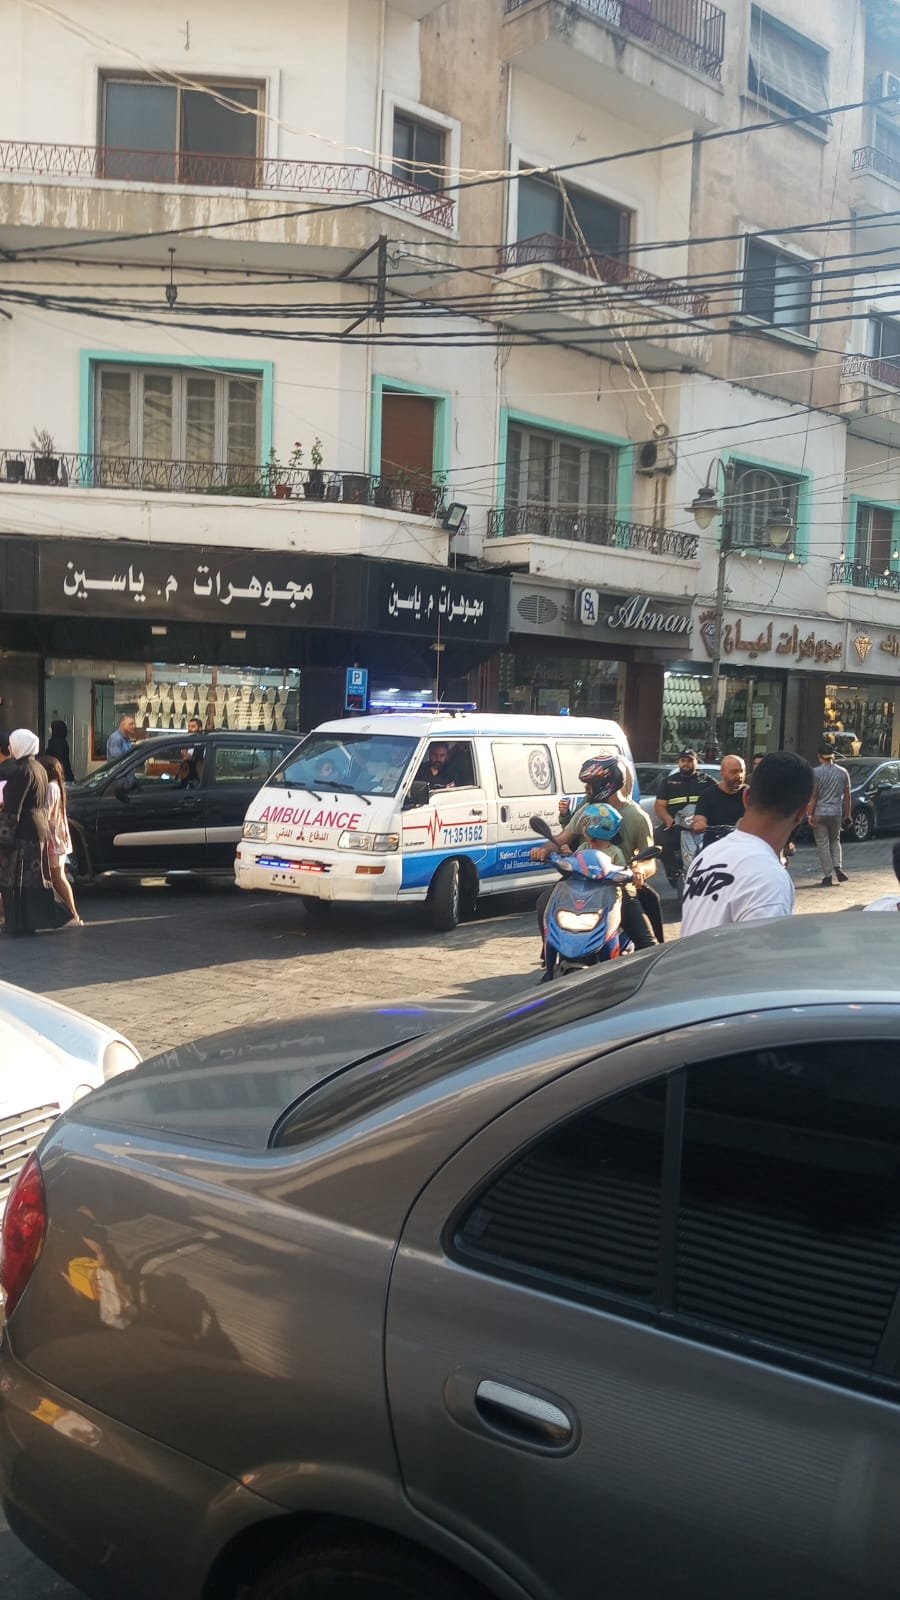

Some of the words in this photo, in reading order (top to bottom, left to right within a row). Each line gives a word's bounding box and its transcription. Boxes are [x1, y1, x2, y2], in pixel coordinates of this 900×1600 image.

[62, 560, 146, 603] ياسين
[192, 564, 314, 609] مجوهرات
[387, 581, 422, 620] ياسين
[438, 584, 484, 625] مجوهرات
[776, 622, 844, 664] مجوهرات
[353, 671, 361, 683] P
[258, 804, 363, 831] AMBULANCE
[443, 825, 483, 846] 71-351562
